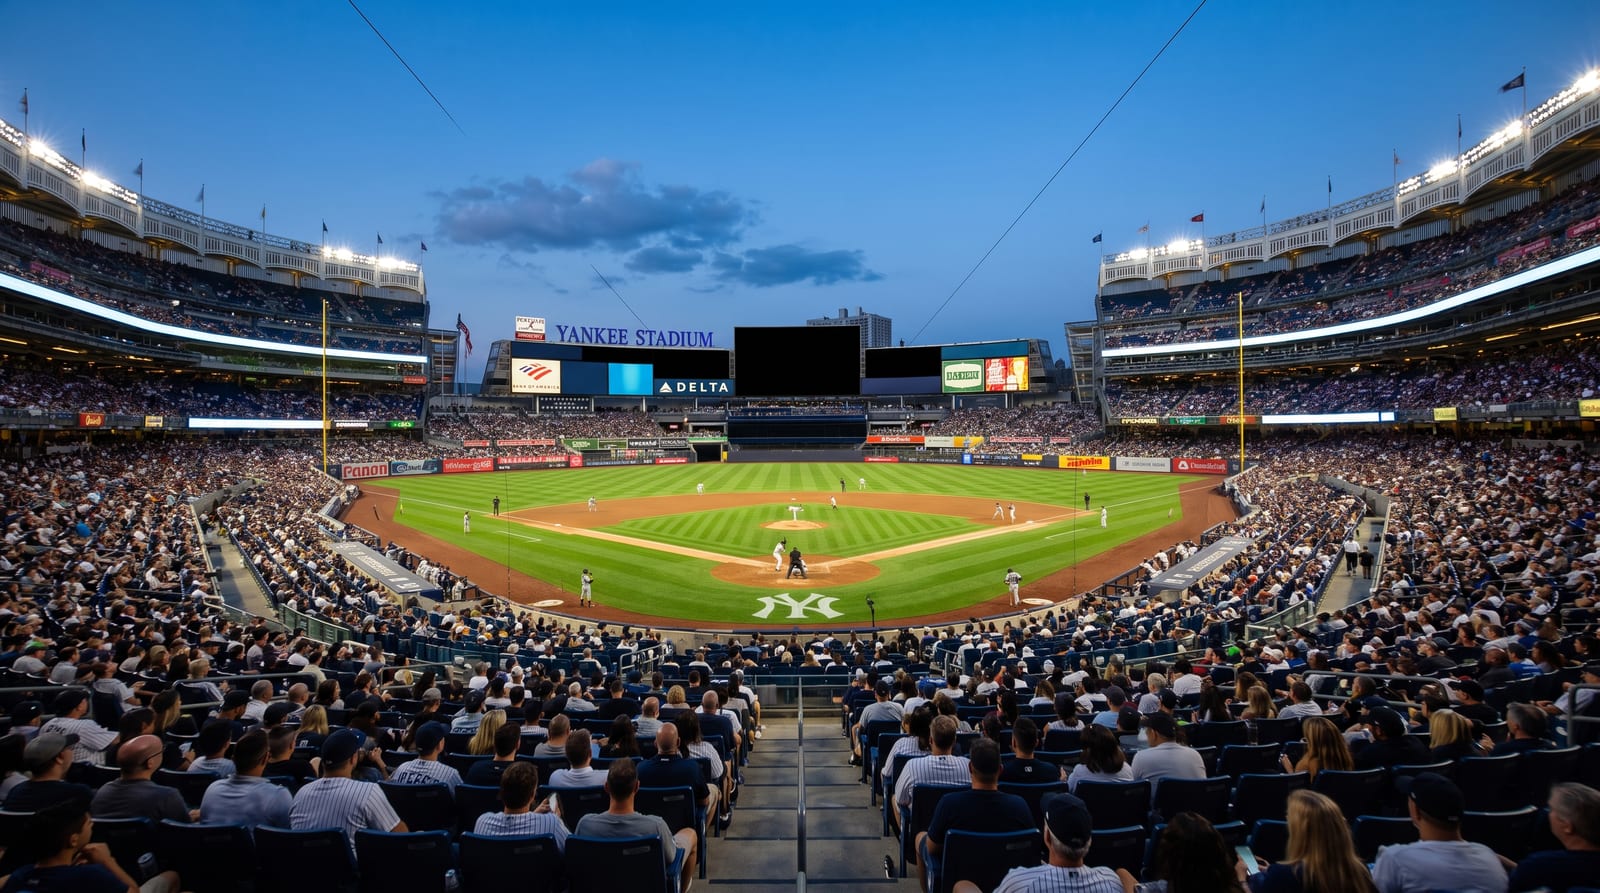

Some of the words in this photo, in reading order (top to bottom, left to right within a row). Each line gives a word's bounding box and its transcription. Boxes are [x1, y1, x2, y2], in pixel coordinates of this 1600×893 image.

[556, 325, 628, 345] YANKEE
[636, 329, 714, 348] STADIUM
[677, 382, 729, 393] DELTA
